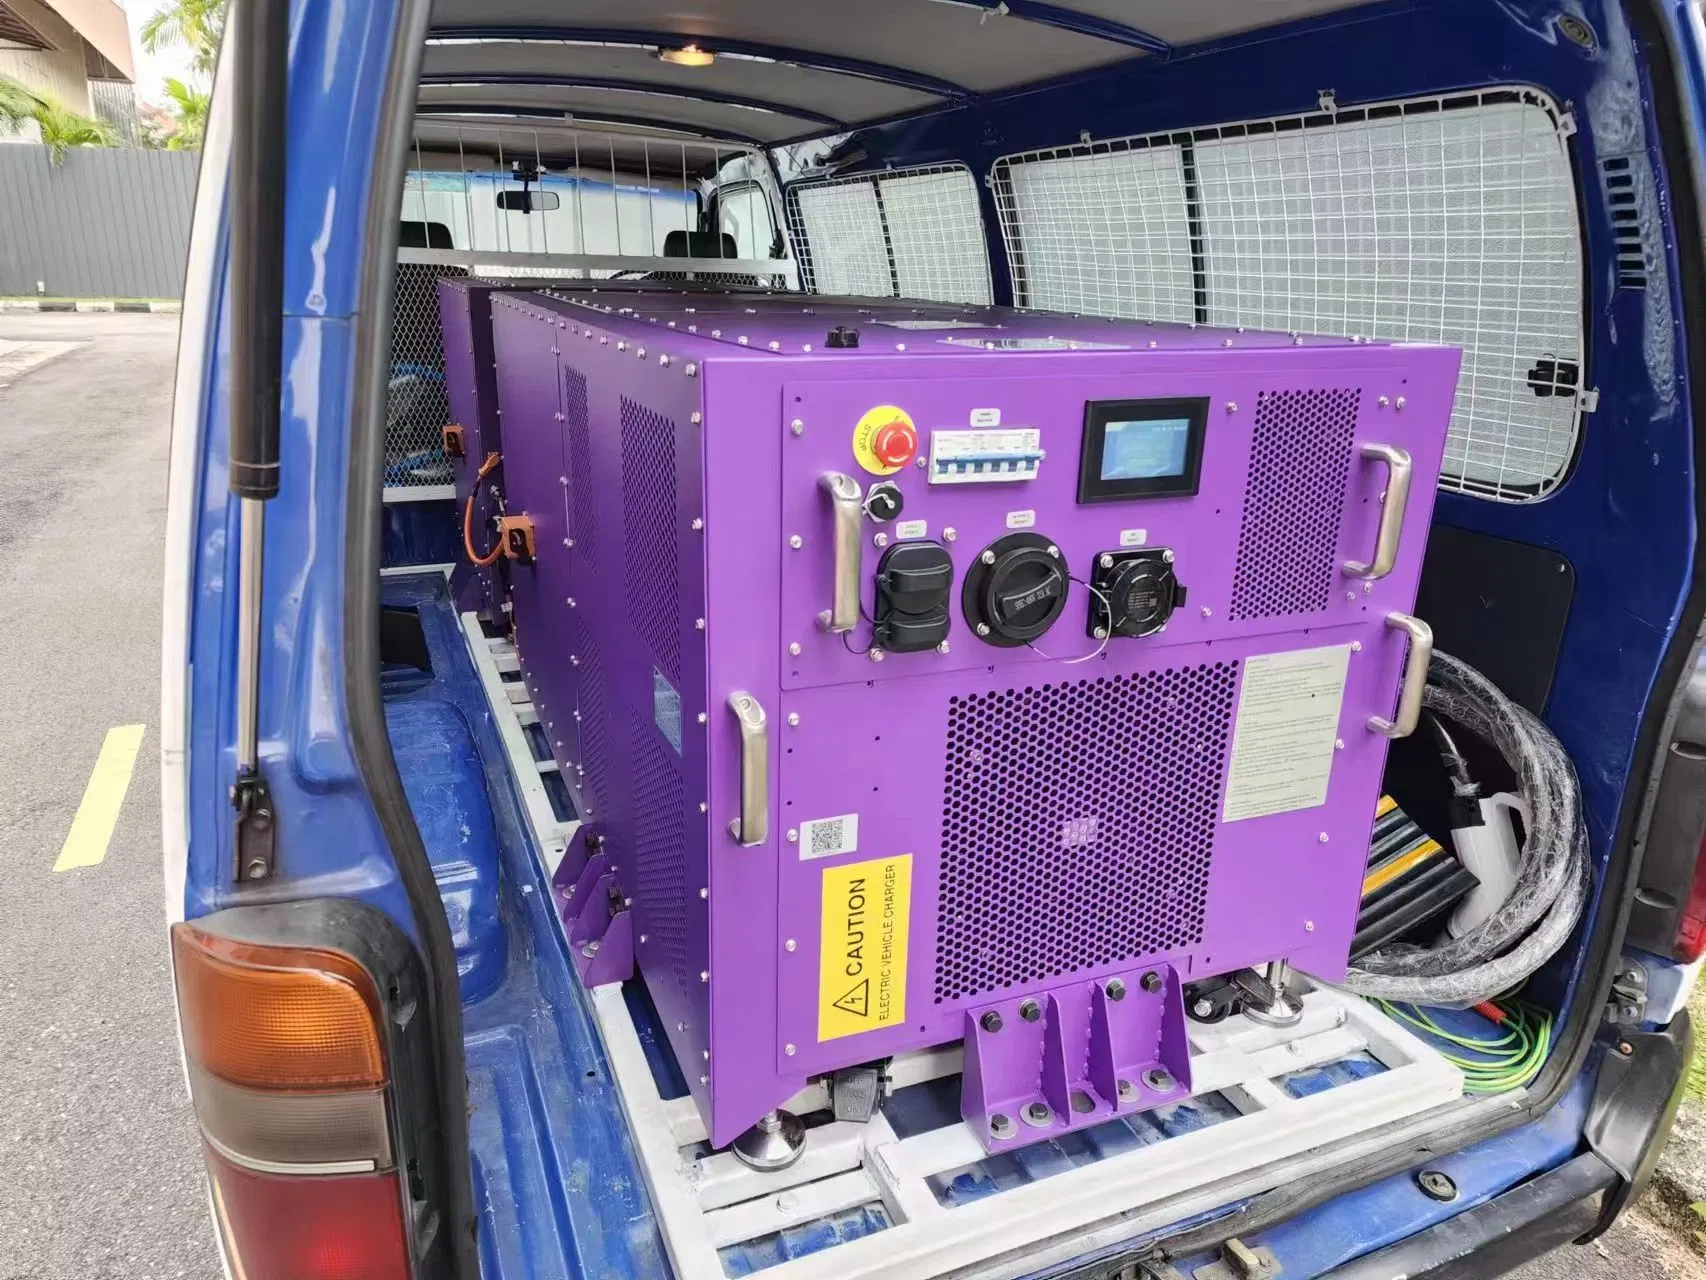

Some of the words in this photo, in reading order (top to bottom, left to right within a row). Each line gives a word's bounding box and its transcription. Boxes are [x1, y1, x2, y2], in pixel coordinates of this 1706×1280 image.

[859, 424, 872, 451] STOP
[883, 864, 896, 918] CHARGER
[846, 878, 866, 976] CAUTION
[881, 920, 893, 967] VEHICLE
[879, 968, 891, 1020] ELECTRIC
